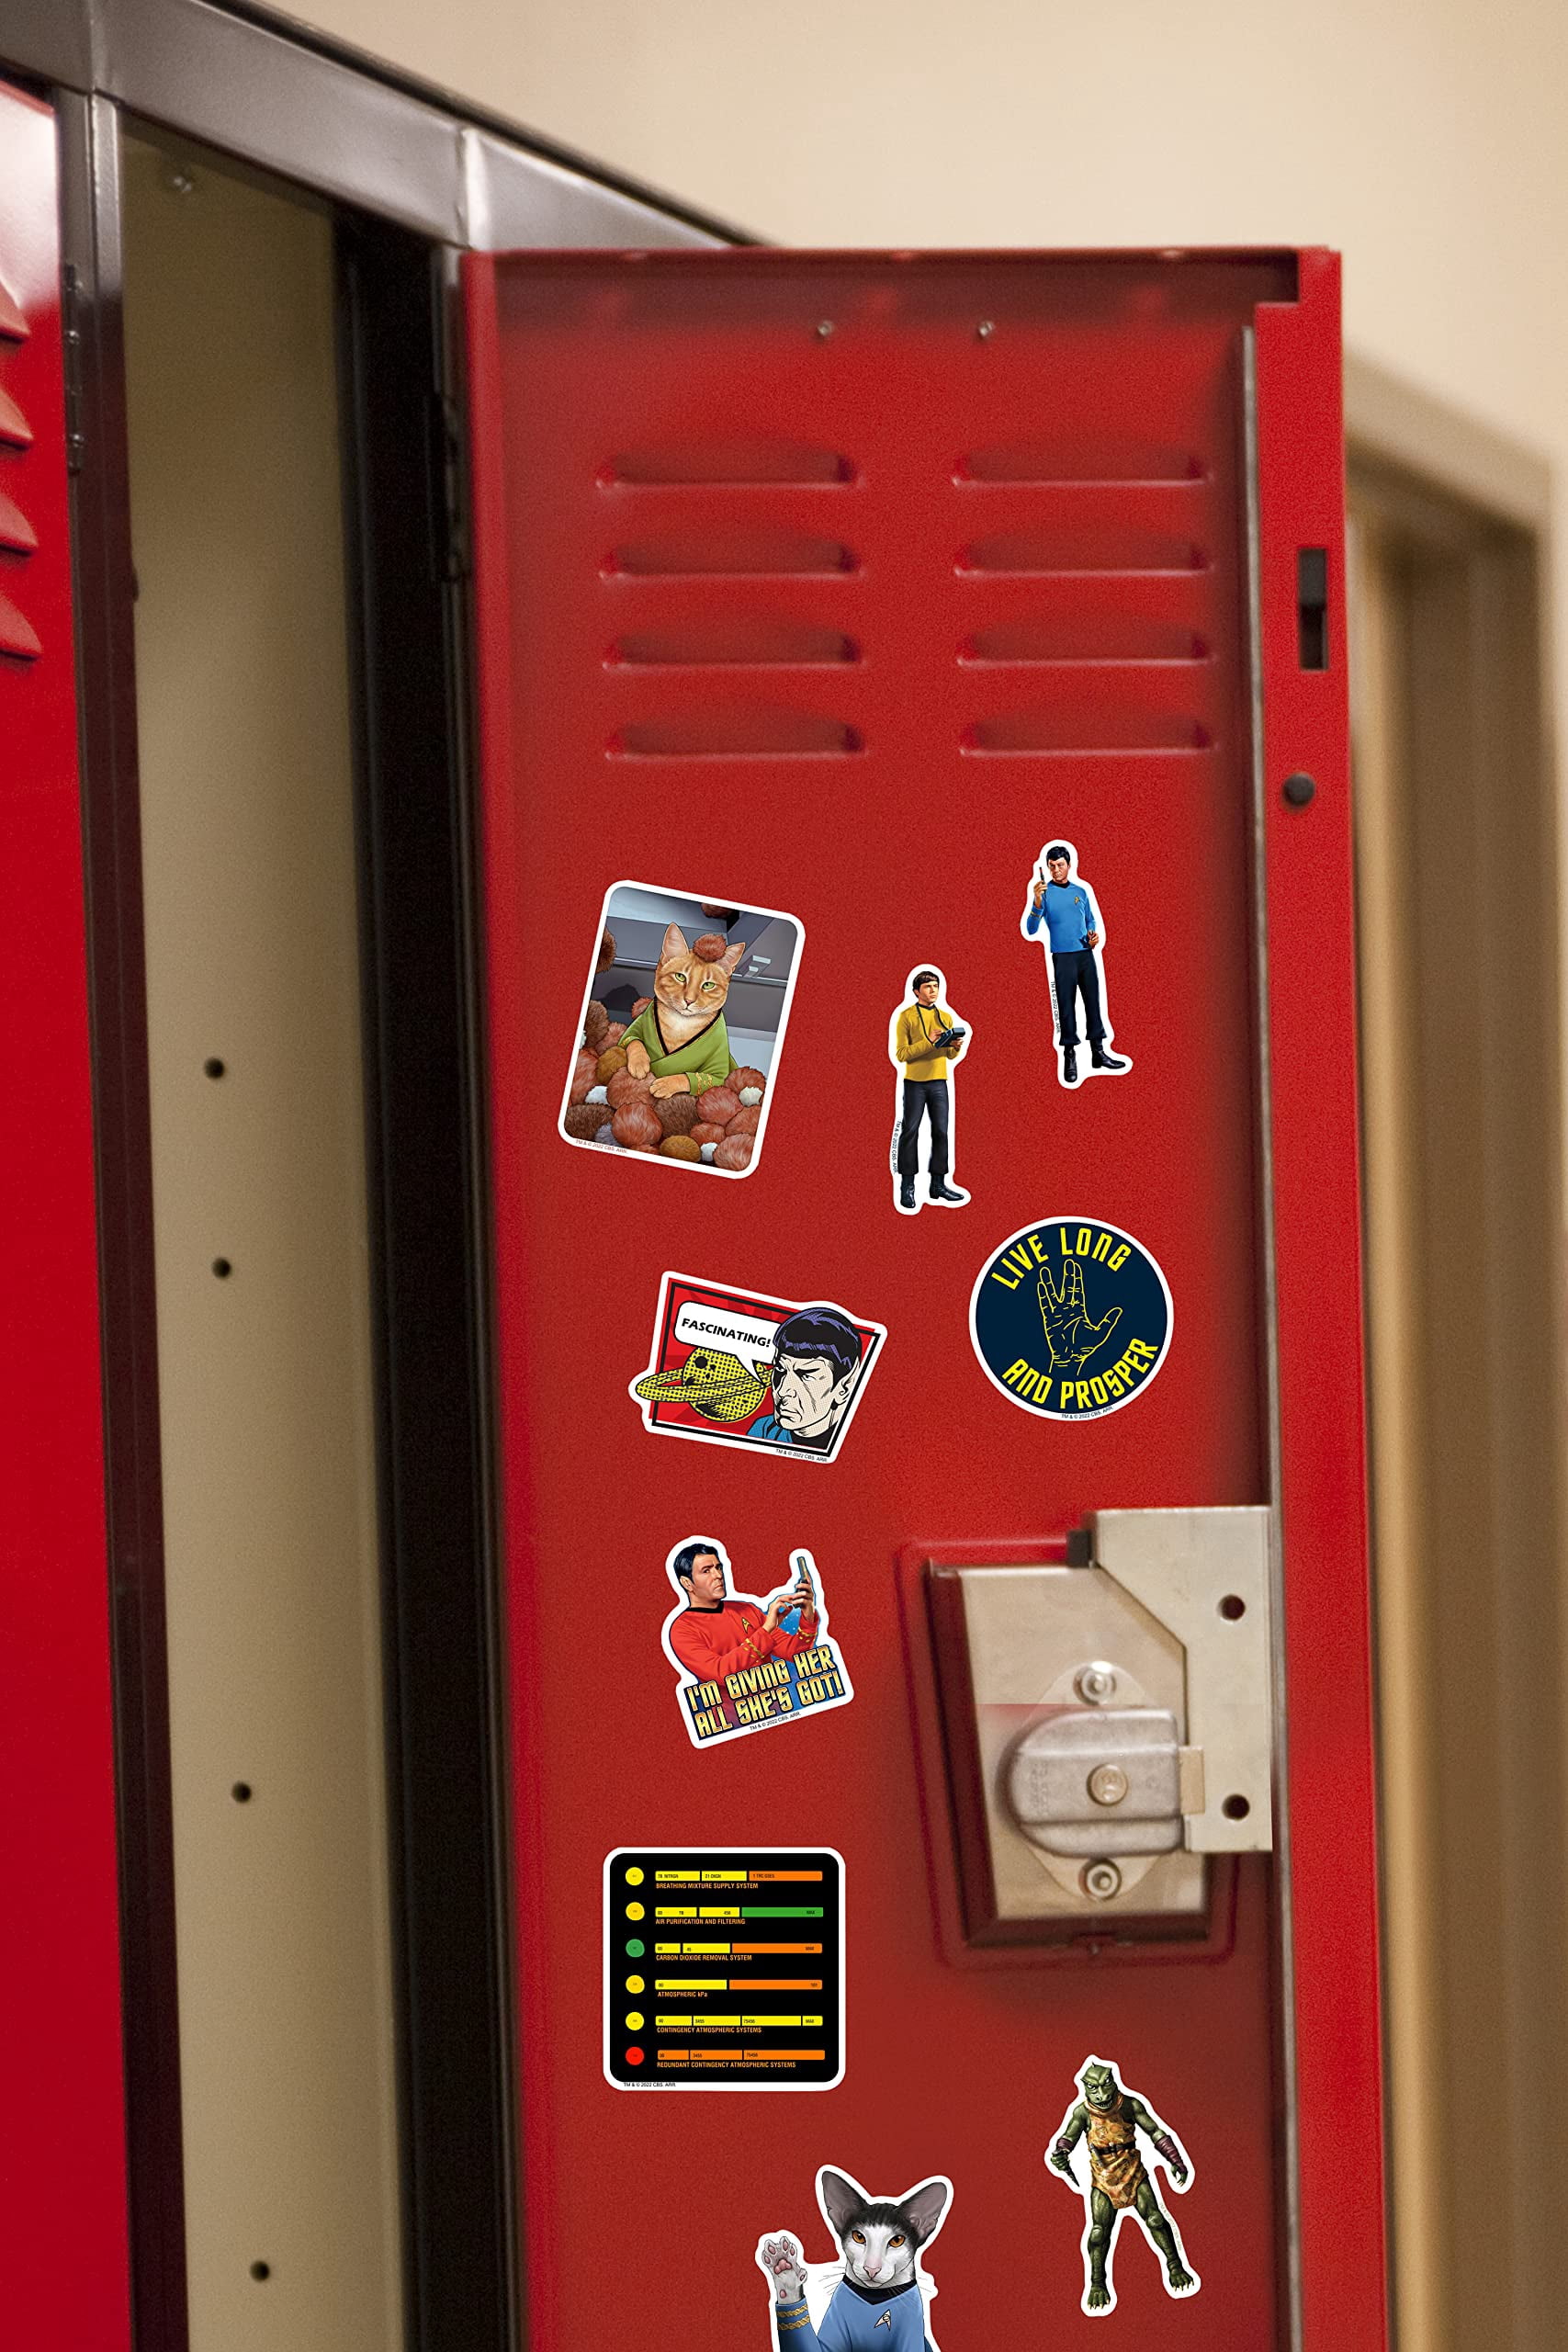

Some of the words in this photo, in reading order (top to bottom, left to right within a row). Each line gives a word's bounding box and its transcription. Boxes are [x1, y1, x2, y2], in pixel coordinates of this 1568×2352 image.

[991, 1234, 1049, 1290] LIVE
[1059, 1227, 1132, 1272] LONG
[681, 1317, 772, 1348] FASCINATING!
[1001, 1358, 1053, 1405] AND
[1059, 1338, 1158, 1409] PROSPER
[686, 1680, 723, 1712] I'M
[725, 1659, 792, 1700] GIVING
[793, 1645, 837, 1679] HER
[694, 1706, 733, 1737] ALL
[735, 1686, 793, 1724] SHE'S
[795, 1670, 845, 1706] GOT!
